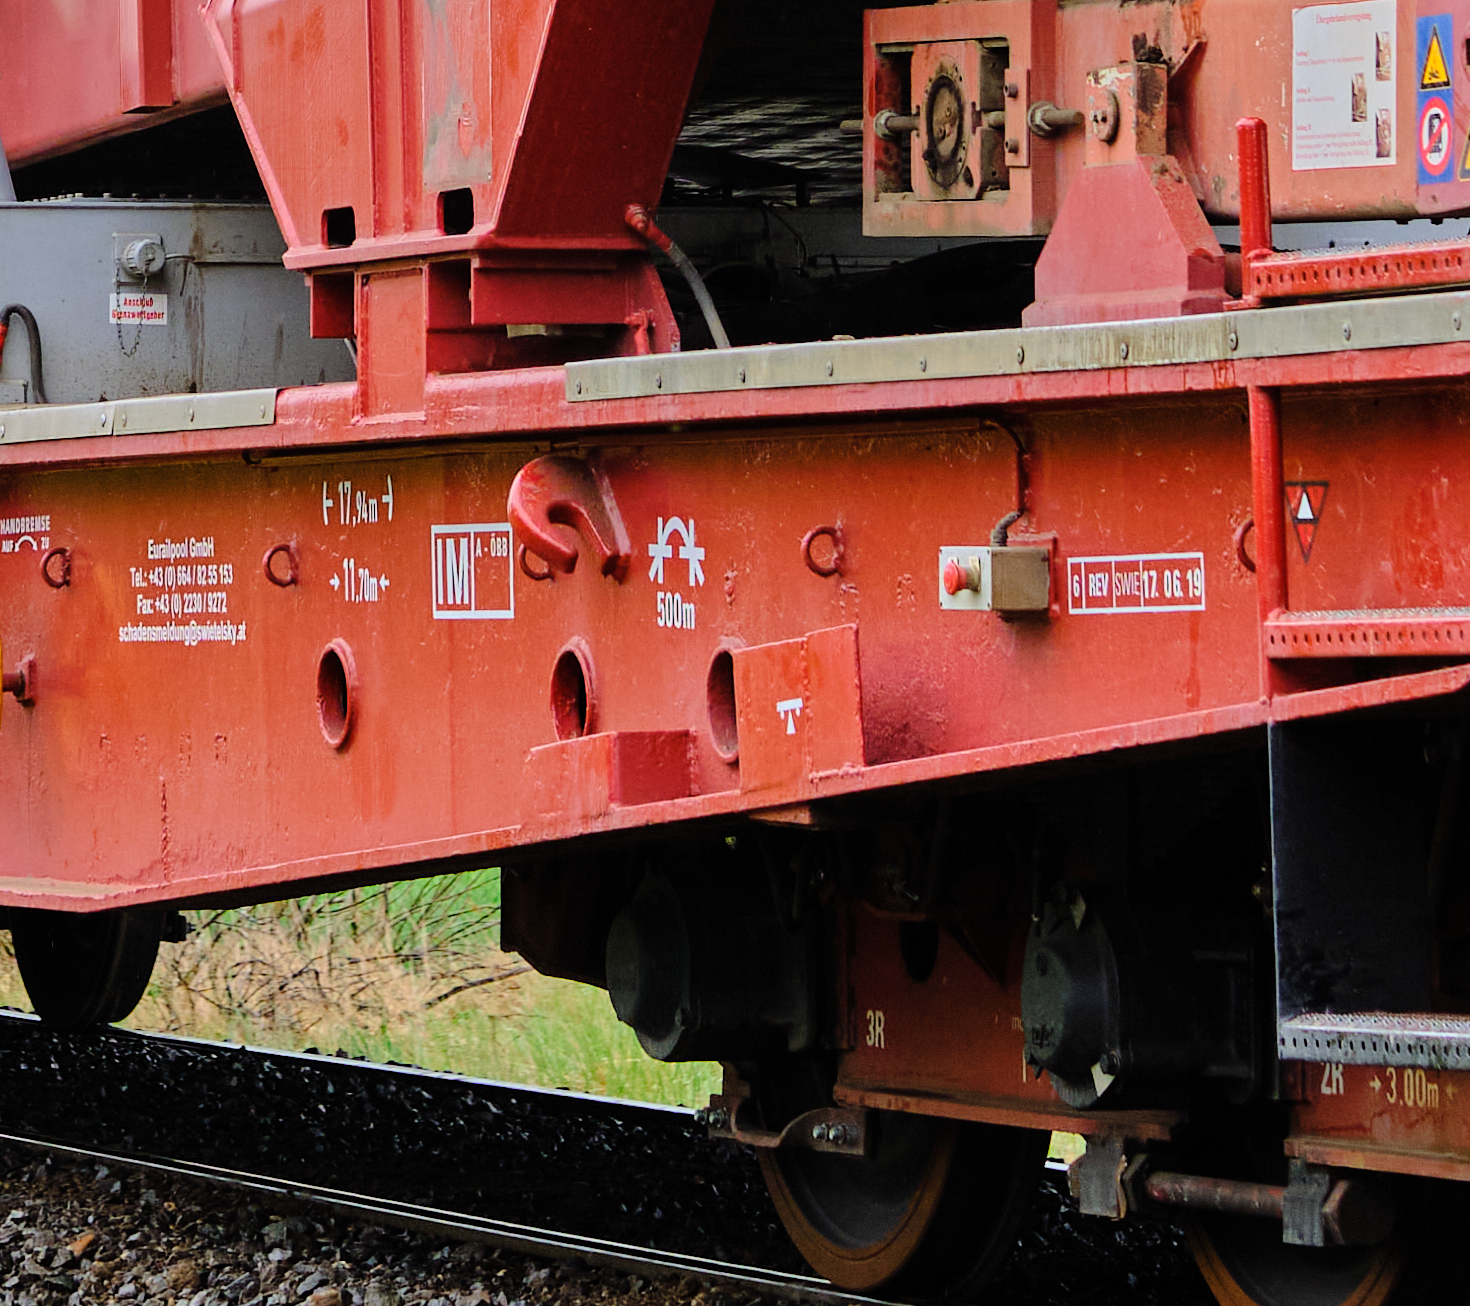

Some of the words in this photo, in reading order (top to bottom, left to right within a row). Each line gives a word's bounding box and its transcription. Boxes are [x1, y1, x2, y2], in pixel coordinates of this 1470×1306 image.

[337, 480, 378, 528] 17,94m
[0, 515, 50, 536] HANDBREMSE
[147, 538, 189, 564] Eurailpool
[189, 536, 215, 558] GmbH
[475, 537, 482, 558] A
[489, 532, 508, 558] ÖBB
[148, 566, 164, 587] +43
[164, 566, 176, 592] (0)
[177, 565, 191, 587] 664
[196, 564, 207, 587] 82
[208, 564, 218, 586] 55
[219, 563, 234, 585] 153
[343, 557, 378, 605] 11,70m
[437, 538, 469, 605] IM
[1072, 574, 1080, 598] 6
[1088, 572, 1109, 598] REV
[1115, 570, 1141, 597] SWIE
[1185, 567, 1202, 599] 19
[154, 593, 170, 614] +43
[170, 592, 182, 619] (0)
[183, 591, 202, 614] 2230
[207, 591, 228, 613] 9272
[657, 590, 696, 630] 500m
[118, 619, 247, 646] schadensmeldung@swietelsky.at
[866, 1009, 885, 1050] 3R
[1385, 1066, 1440, 1110] 3.00m
